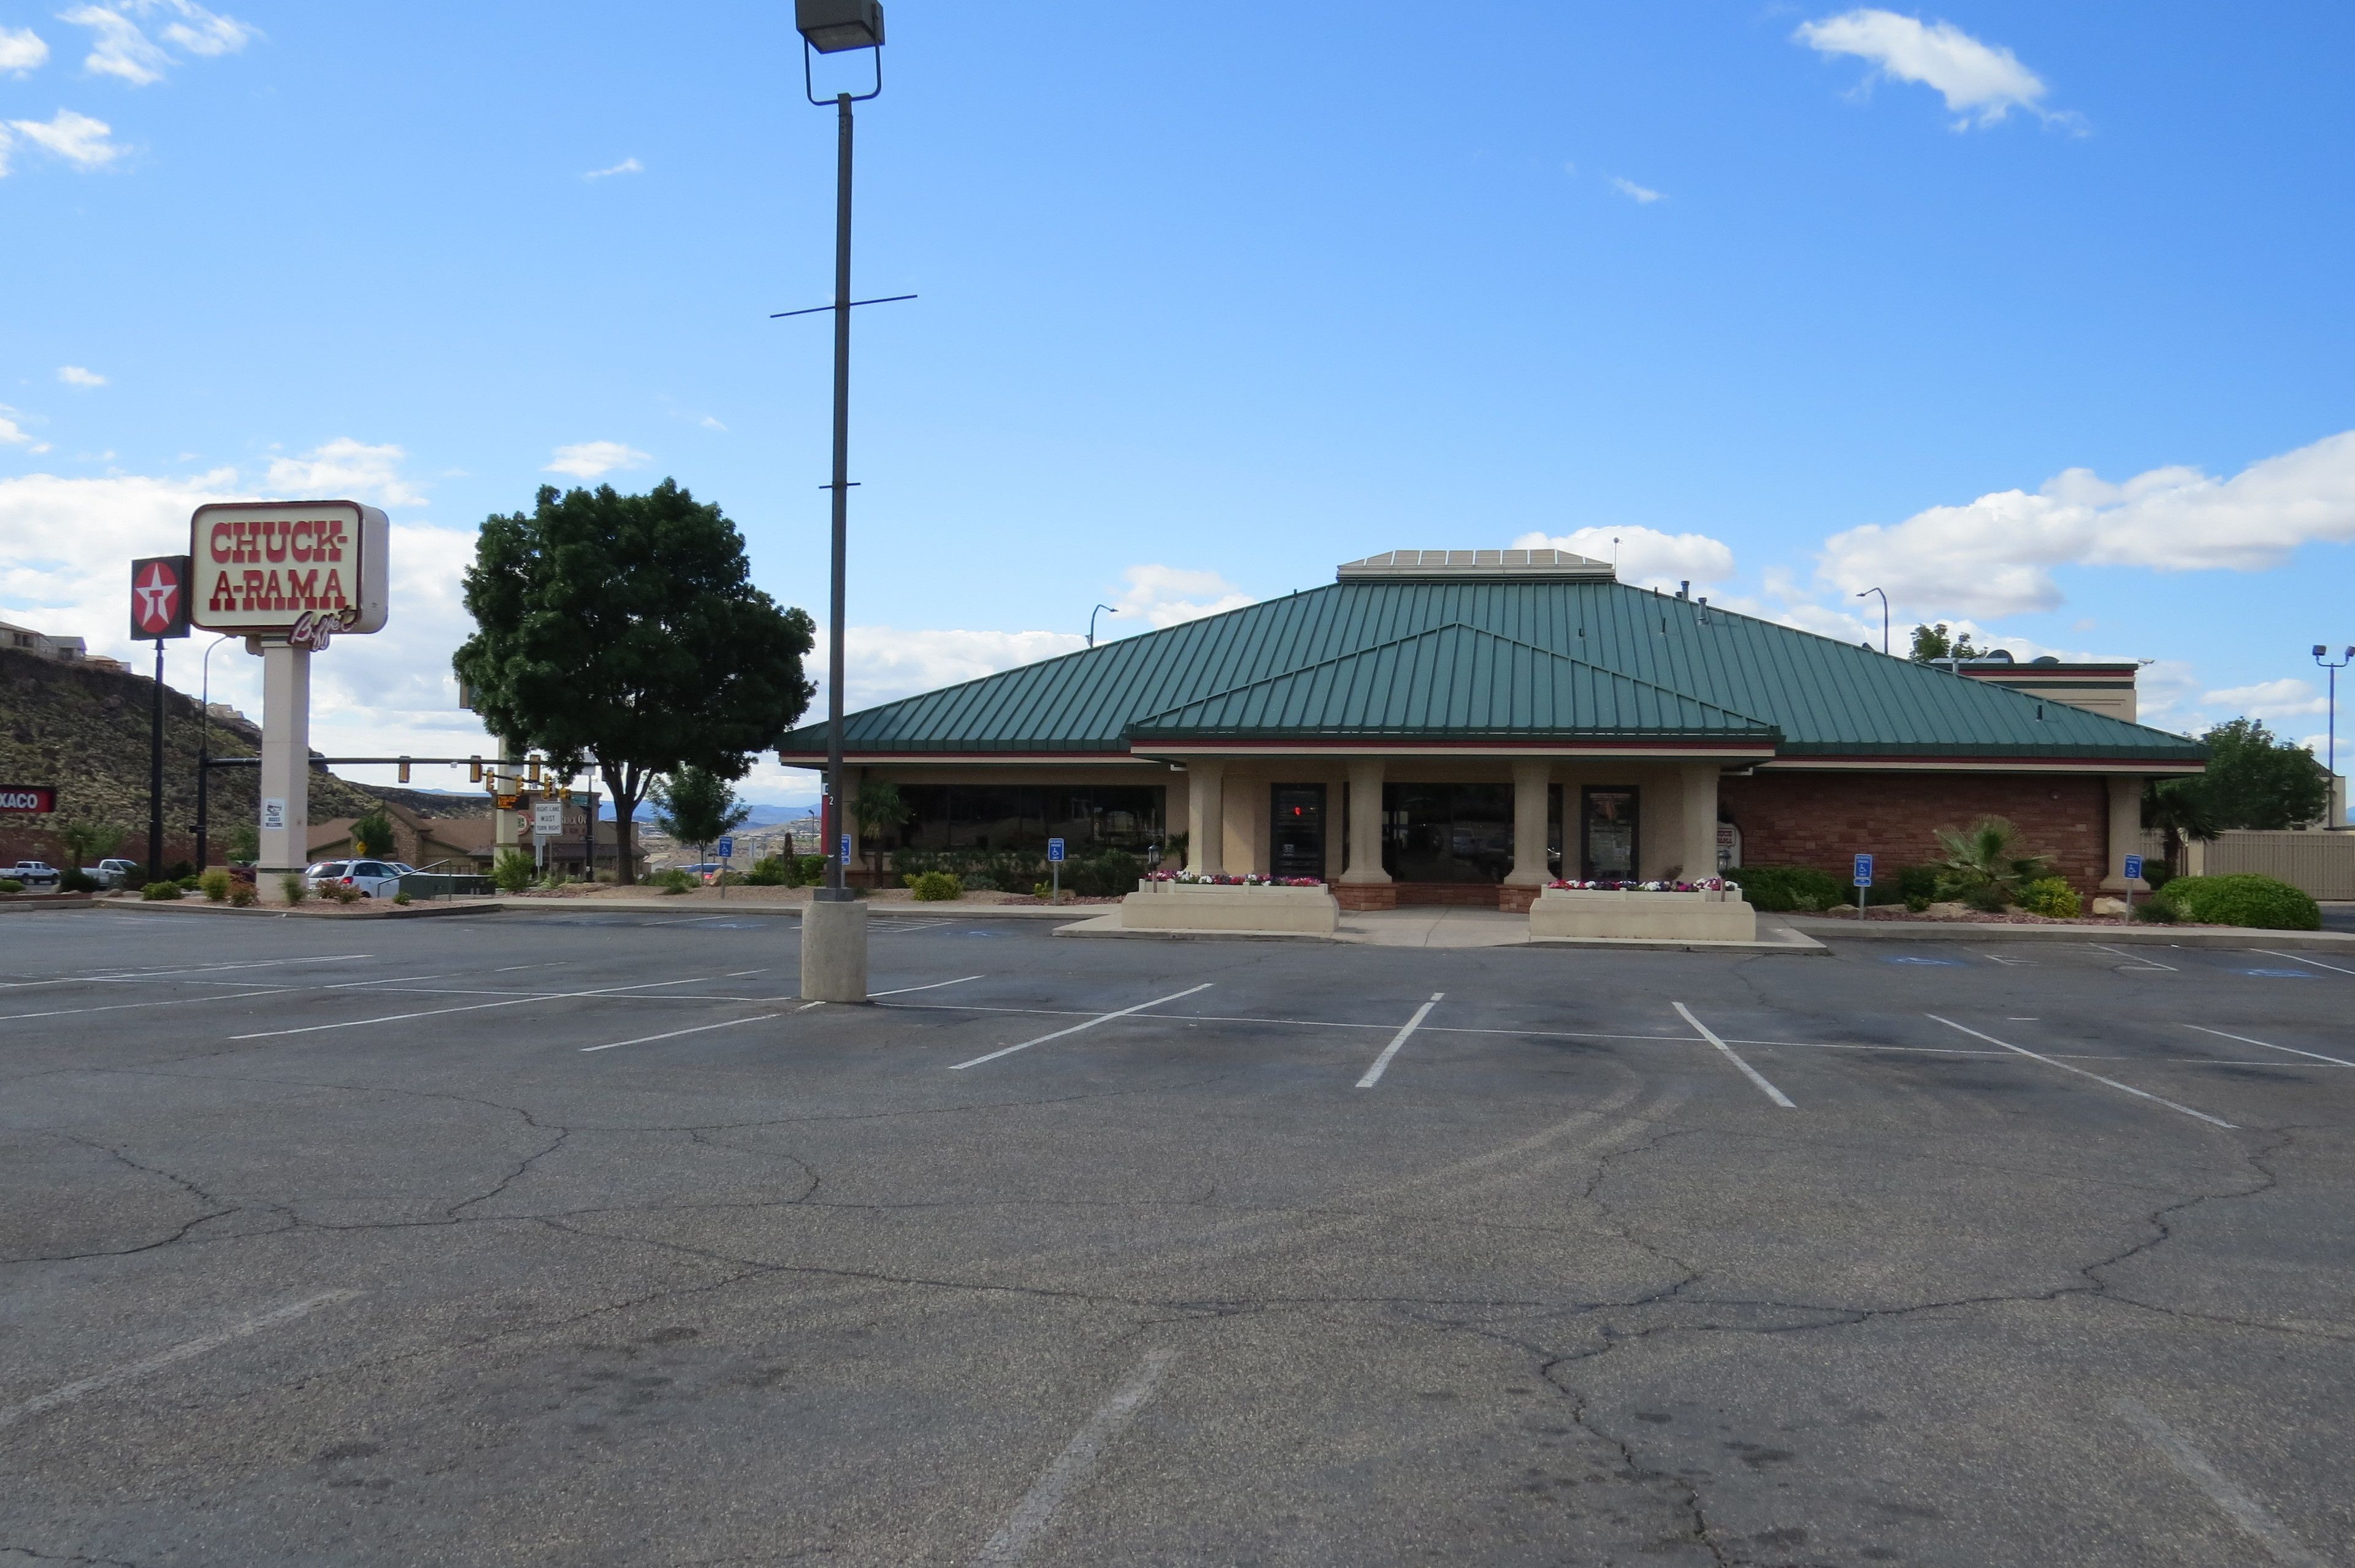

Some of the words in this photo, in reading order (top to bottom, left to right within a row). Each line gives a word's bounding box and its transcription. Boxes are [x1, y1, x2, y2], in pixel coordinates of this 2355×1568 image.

[210, 521, 348, 564] CHUCK-
[209, 568, 347, 611] A-RAMA
[288, 605, 358, 651] Bffet
